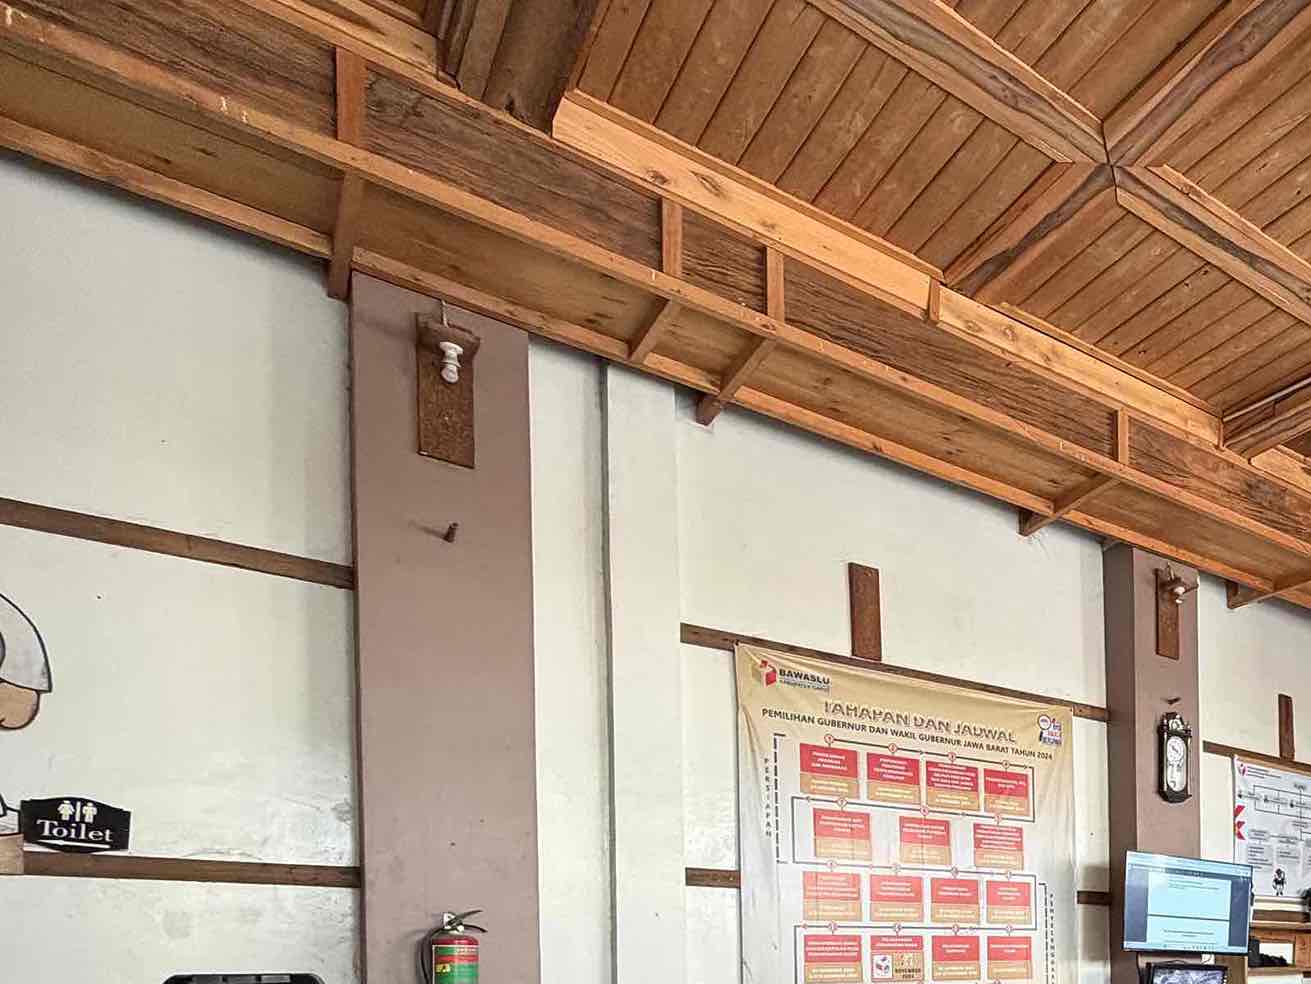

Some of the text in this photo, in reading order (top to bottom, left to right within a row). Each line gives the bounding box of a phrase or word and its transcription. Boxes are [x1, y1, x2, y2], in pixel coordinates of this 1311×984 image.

[779, 668, 831, 685] BAWASLU
[761, 708, 1053, 761] PEMILIHAN GUBERNUR DAN WAKIL GUBERNUR JAWA BARAT TAHUN 2024
[824, 700, 909, 726] TAHAPAN
[914, 716, 949, 733] DAN
[954, 722, 1017, 743] JADWAL
[36, 819, 113, 842] Toilet
